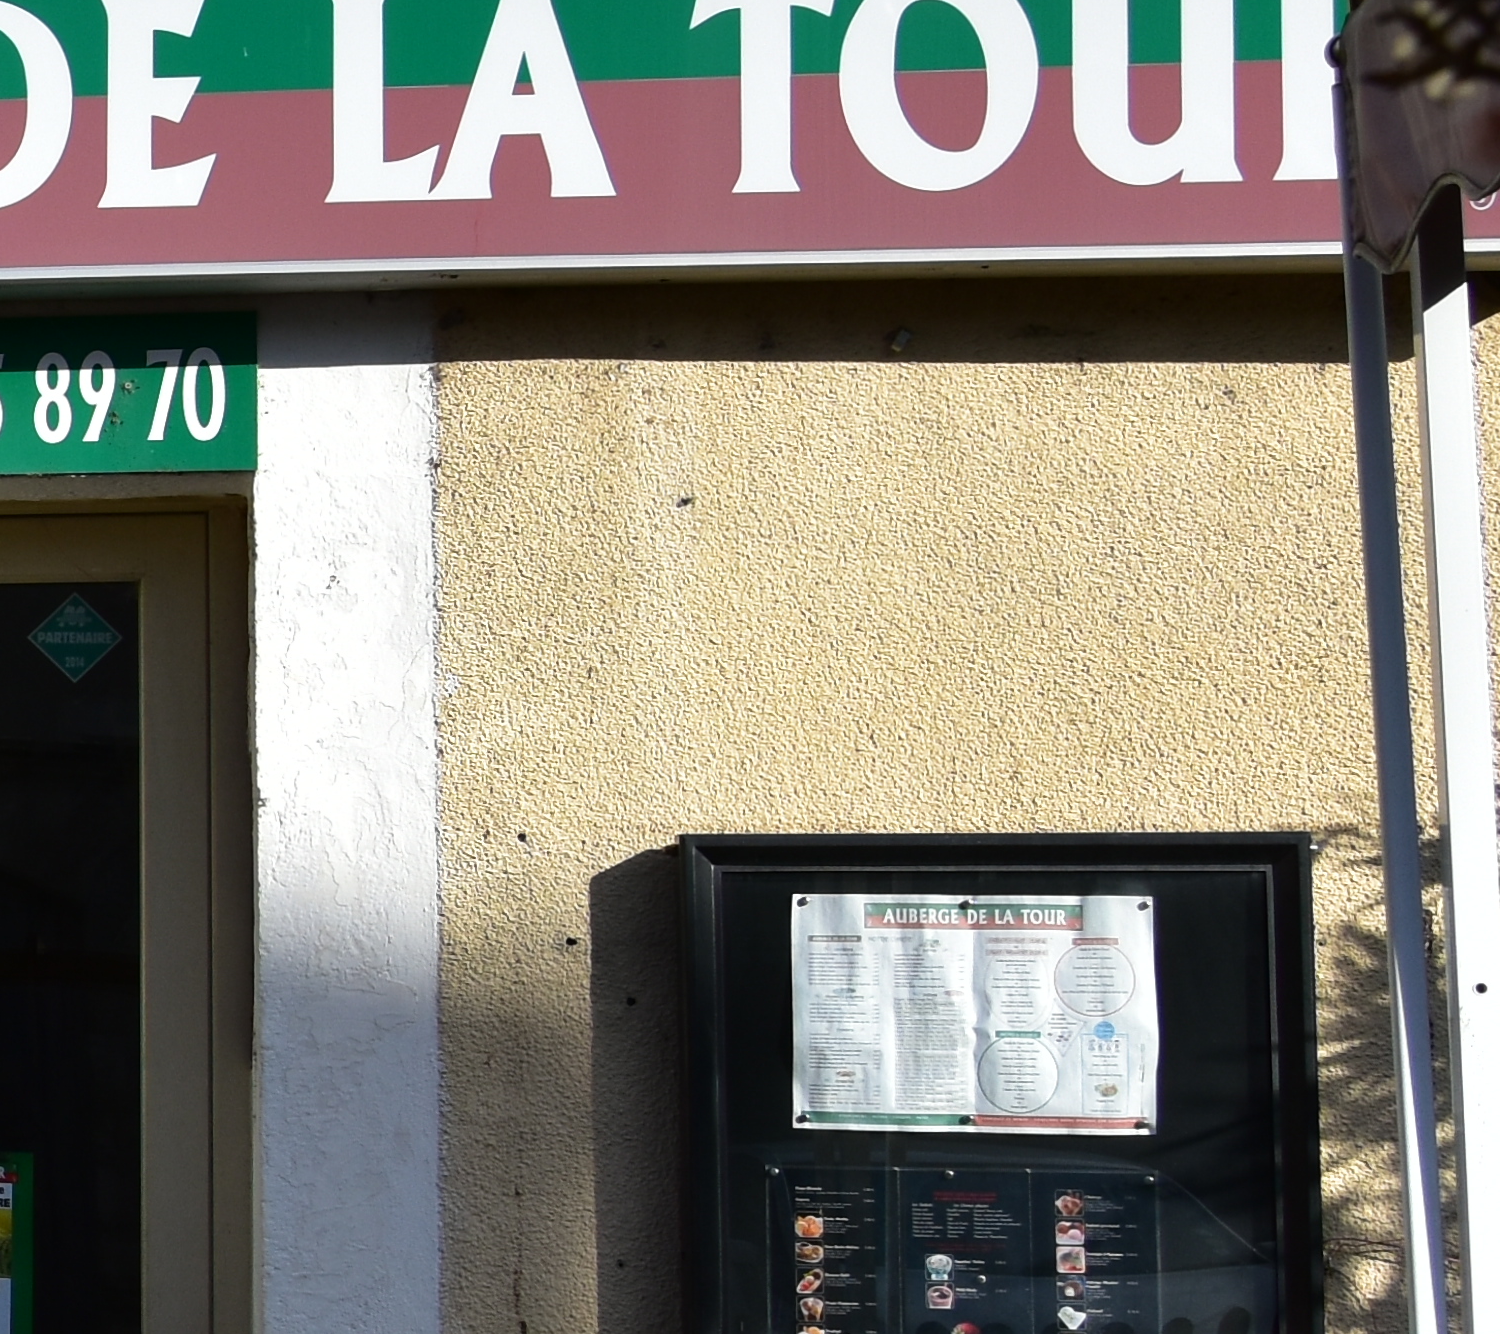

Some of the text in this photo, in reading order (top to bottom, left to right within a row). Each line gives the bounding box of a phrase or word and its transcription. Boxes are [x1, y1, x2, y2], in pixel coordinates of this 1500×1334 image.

[33, 351, 115, 444] 89
[145, 347, 227, 442] 70
[37, 631, 114, 644] PARTENAIRE
[883, 907, 1068, 926] AUBERGE DE LA TOUR
